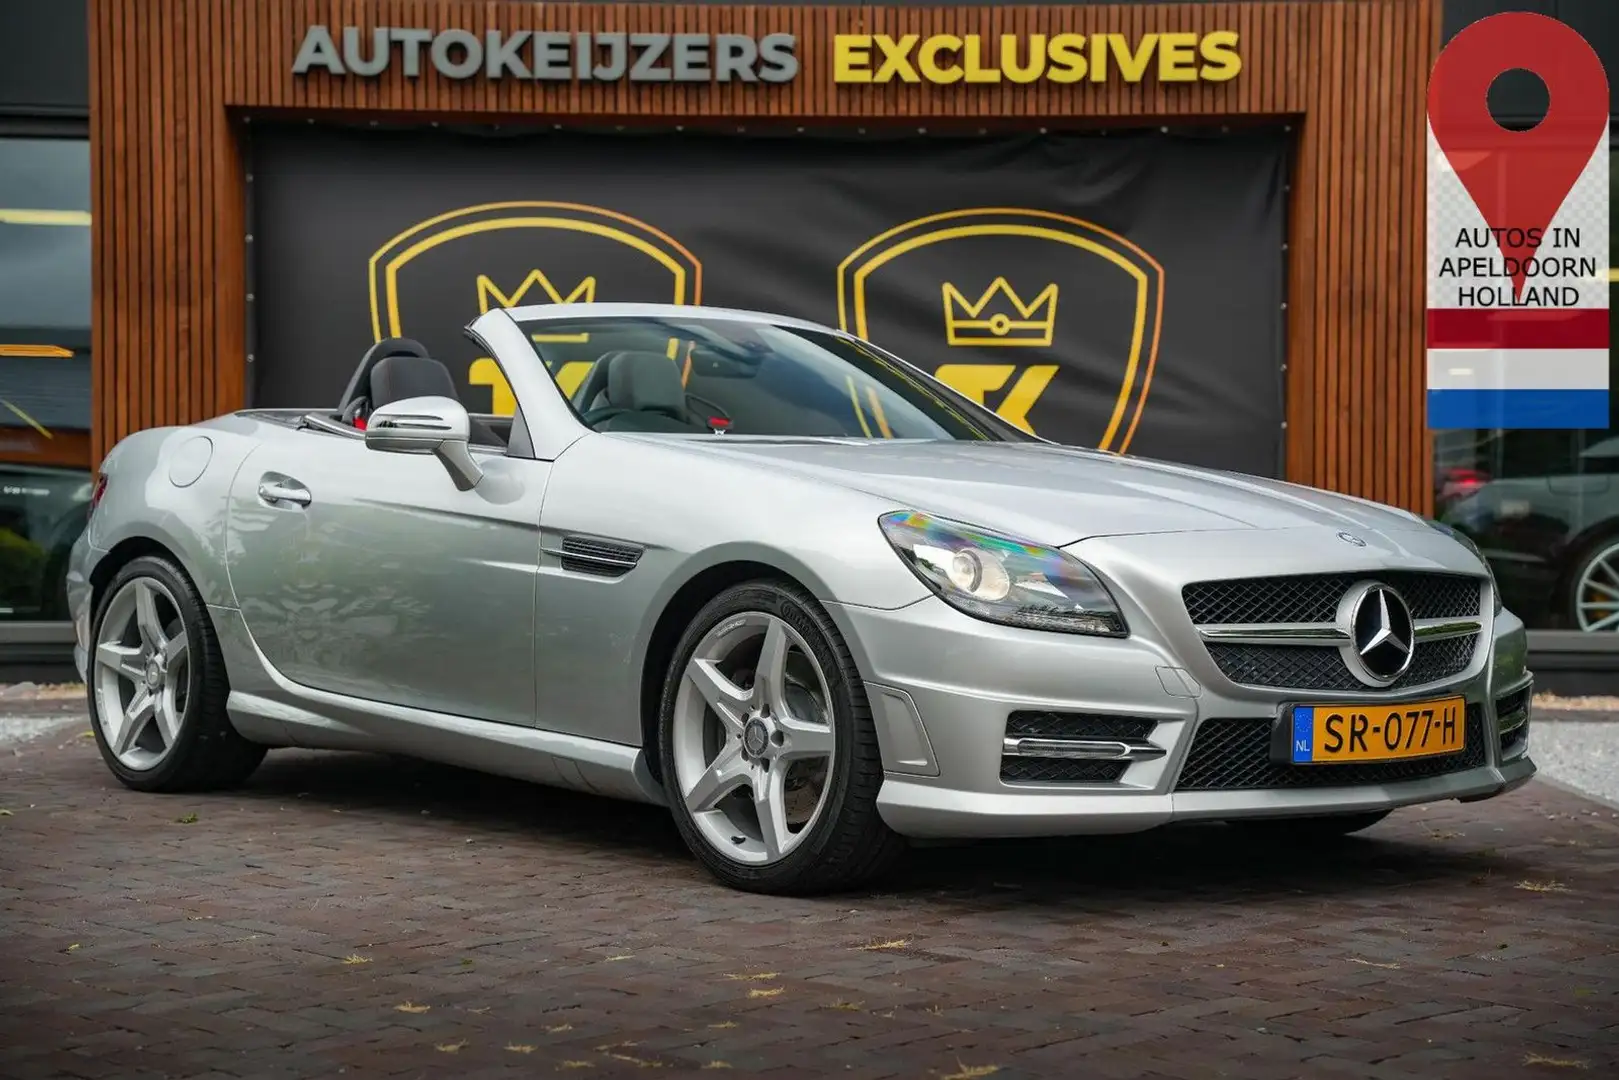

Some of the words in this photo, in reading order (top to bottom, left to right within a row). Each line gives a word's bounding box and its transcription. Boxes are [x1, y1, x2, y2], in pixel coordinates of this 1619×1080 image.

[292, 25, 799, 83] AUTOKEIJZERS
[834, 31, 1242, 84] EXCLUSIVES
[1295, 740, 1310, 752] NL
[1324, 707, 1456, 753] SR-077-H
